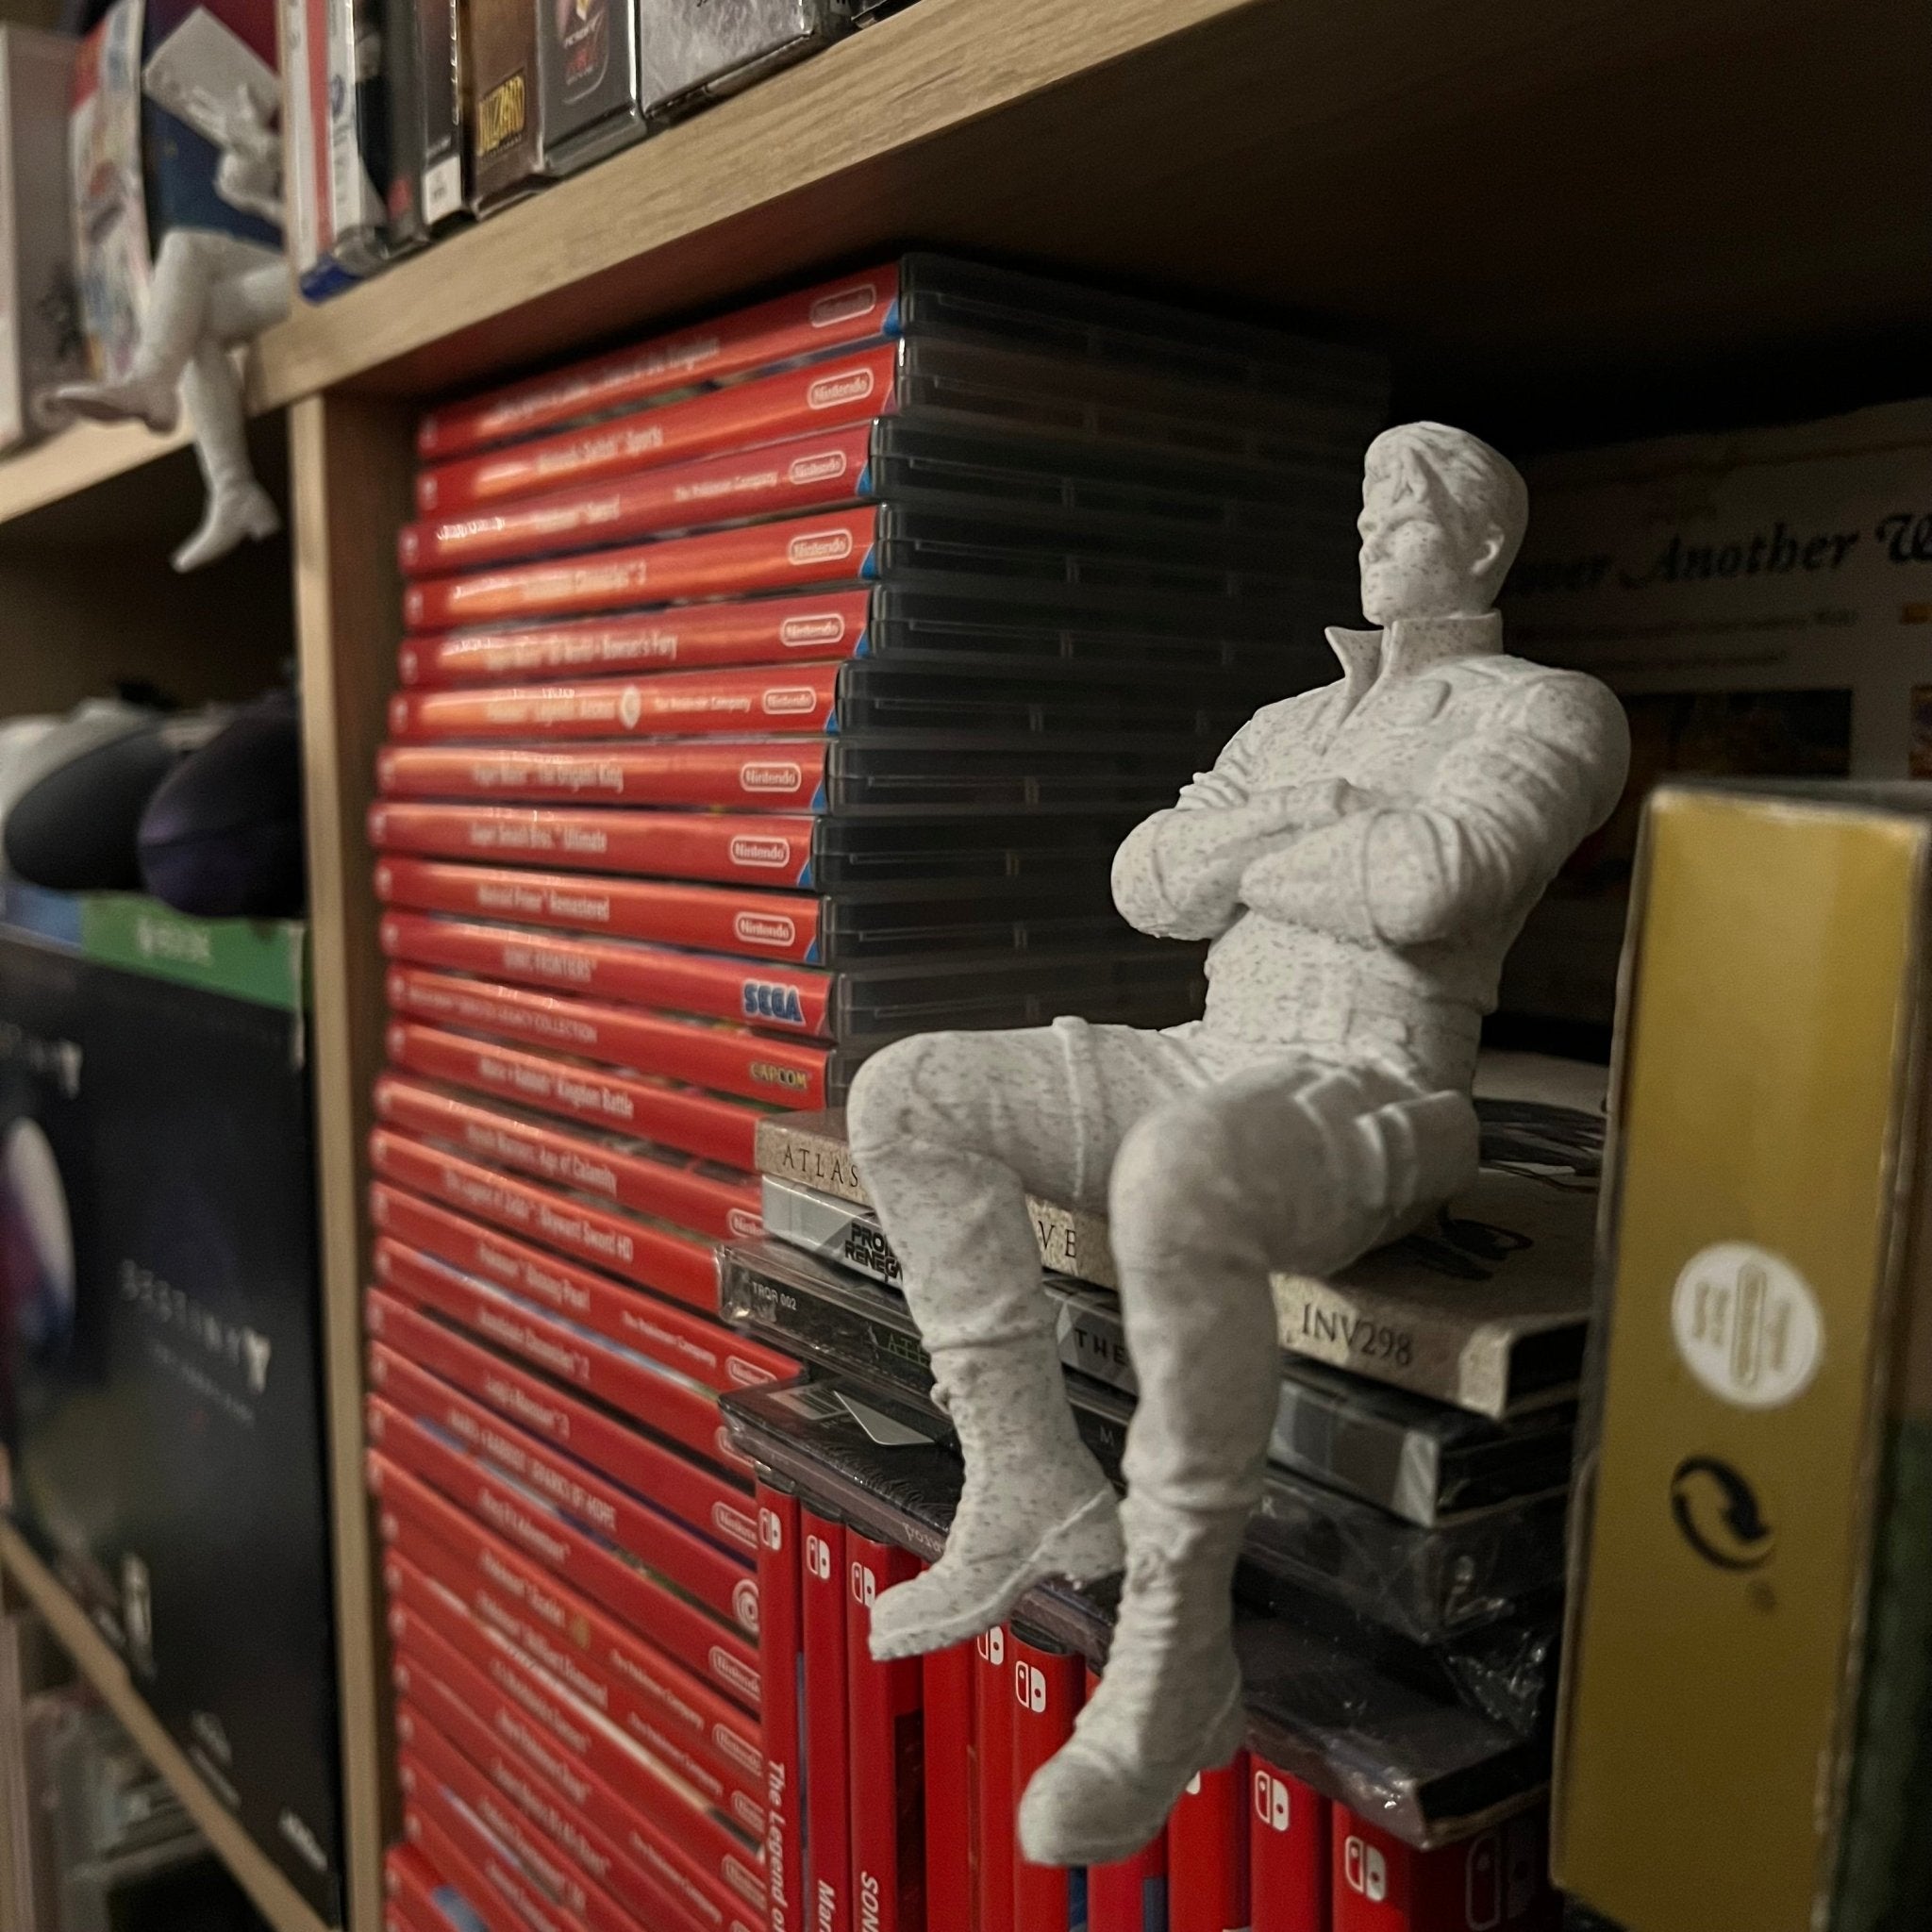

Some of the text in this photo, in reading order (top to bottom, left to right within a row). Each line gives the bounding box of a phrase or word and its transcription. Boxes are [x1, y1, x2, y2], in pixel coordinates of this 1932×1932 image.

[812, 375, 869, 405] Nintendo
[792, 457, 842, 480] Nintendo
[791, 536, 848, 560] Nintendo
[784, 619, 841, 643] Nintendo
[765, 692, 813, 711] Nintendo
[743, 767, 798, 790] Nintendo
[733, 841, 787, 862] Nintendo
[738, 918, 791, 941] Nintendo
[743, 979, 806, 1025] SEGA
[750, 1062, 808, 1091] CAPCOM
[781, 1144, 859, 1188] ATLAS
[780, 1293, 796, 1311] 002
[1302, 1302, 1412, 1366] INV298
[768, 1760, 786, 1807] The
[768, 1810, 789, 1907] Legend
